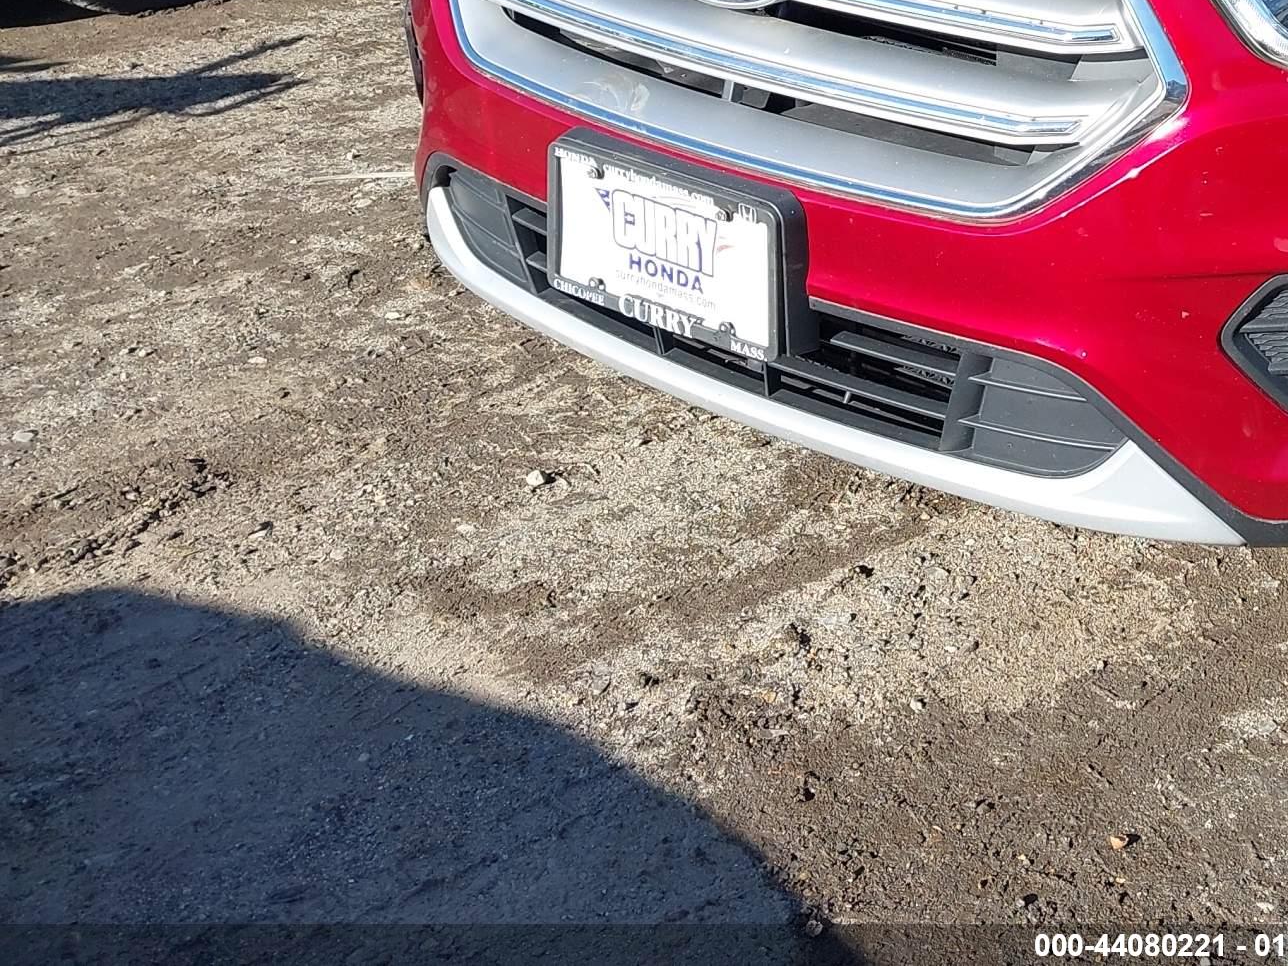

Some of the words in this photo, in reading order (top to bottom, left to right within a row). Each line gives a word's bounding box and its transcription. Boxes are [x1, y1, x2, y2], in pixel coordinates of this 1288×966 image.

[554, 146, 597, 167] HONDA
[612, 189, 717, 277] CURRY
[629, 253, 704, 295] HONDA
[553, 278, 605, 306] CHICOPEE
[618, 293, 697, 339] CURRY
[730, 339, 768, 362] MASS.
